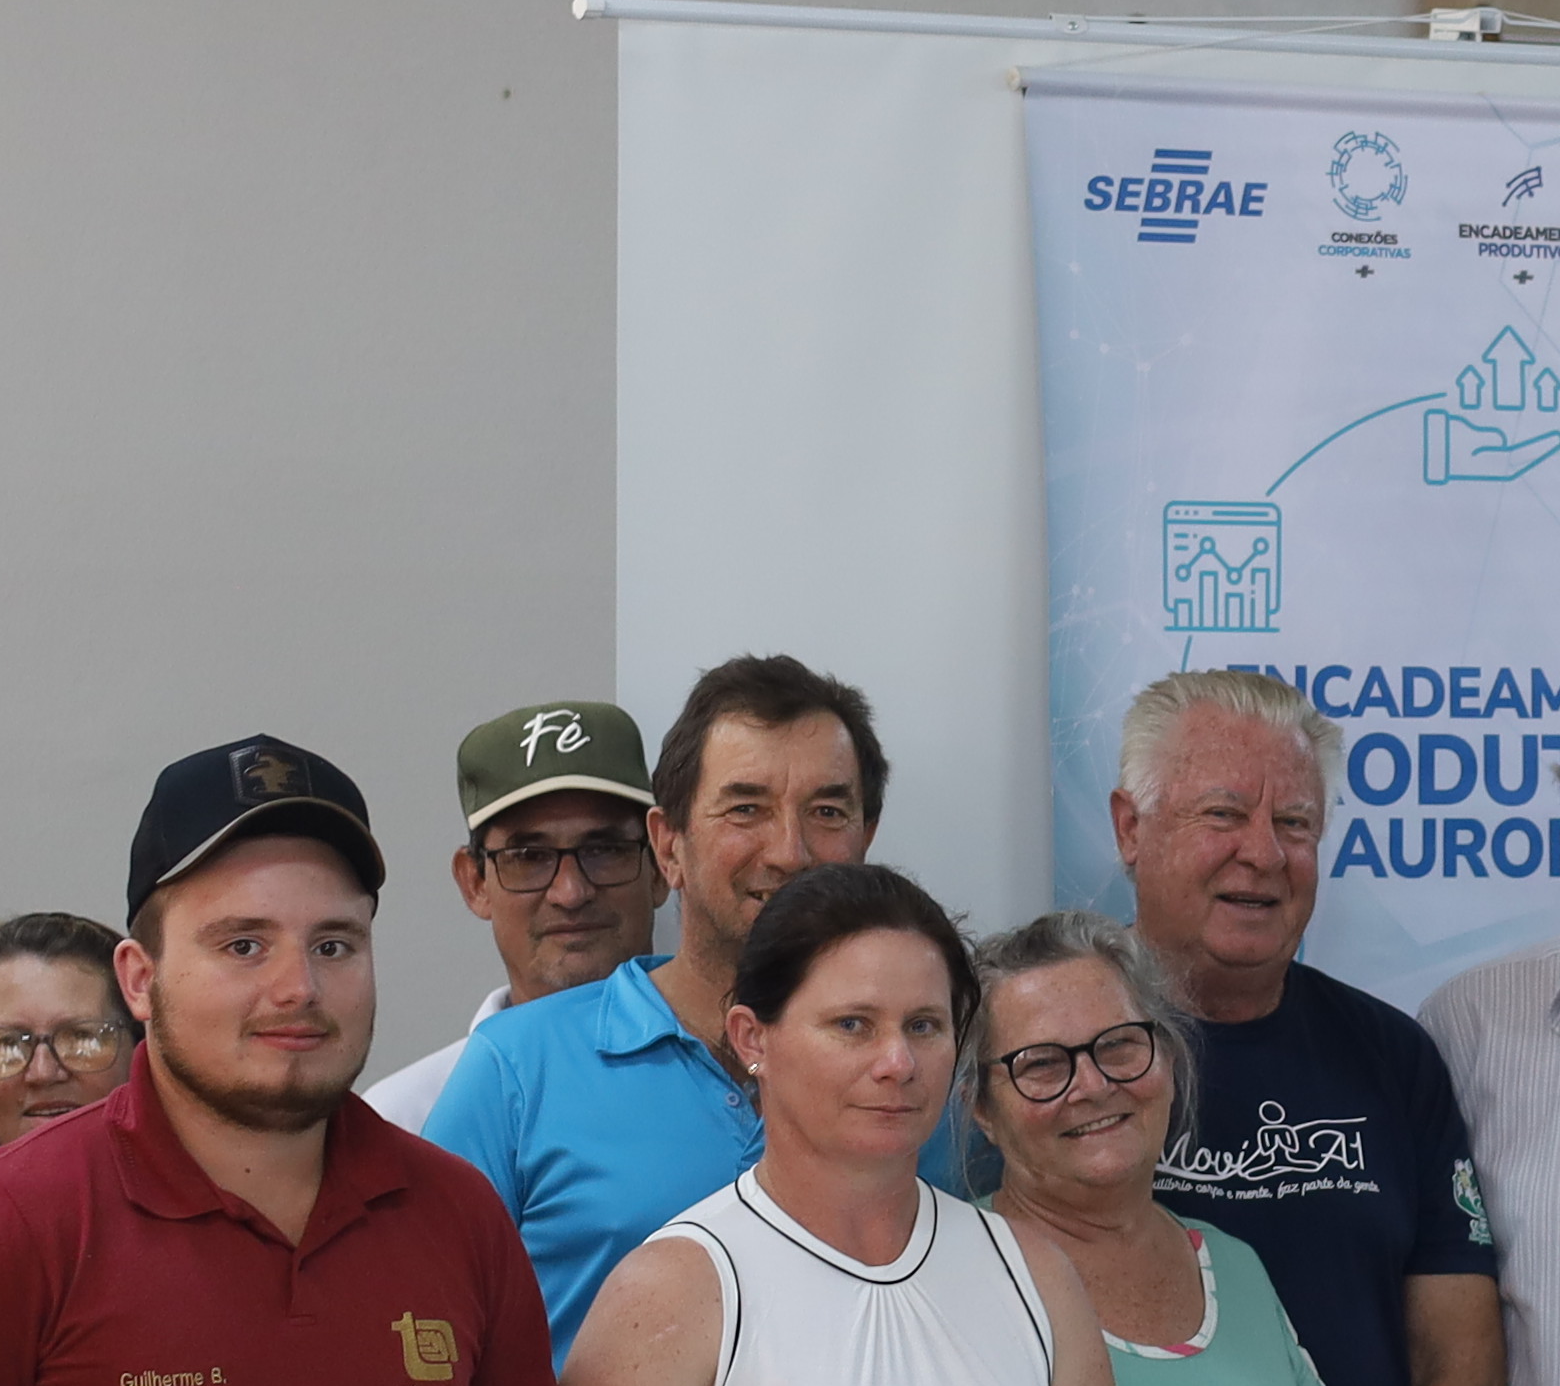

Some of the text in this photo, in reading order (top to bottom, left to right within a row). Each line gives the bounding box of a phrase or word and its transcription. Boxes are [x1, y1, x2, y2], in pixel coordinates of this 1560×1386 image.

[1084, 175, 1268, 217] SEBRAE
[1331, 230, 1398, 246] CONEXÕES
[1318, 244, 1411, 260] CORPORATIVAS
[520, 709, 591, 767] Fé
[1226, 1190, 1234, 1199] e
[1277, 1181, 1300, 1200] faz
[1301, 1177, 1335, 1197] parte
[1336, 1176, 1353, 1190] da
[211, 1367, 227, 1385] B.
